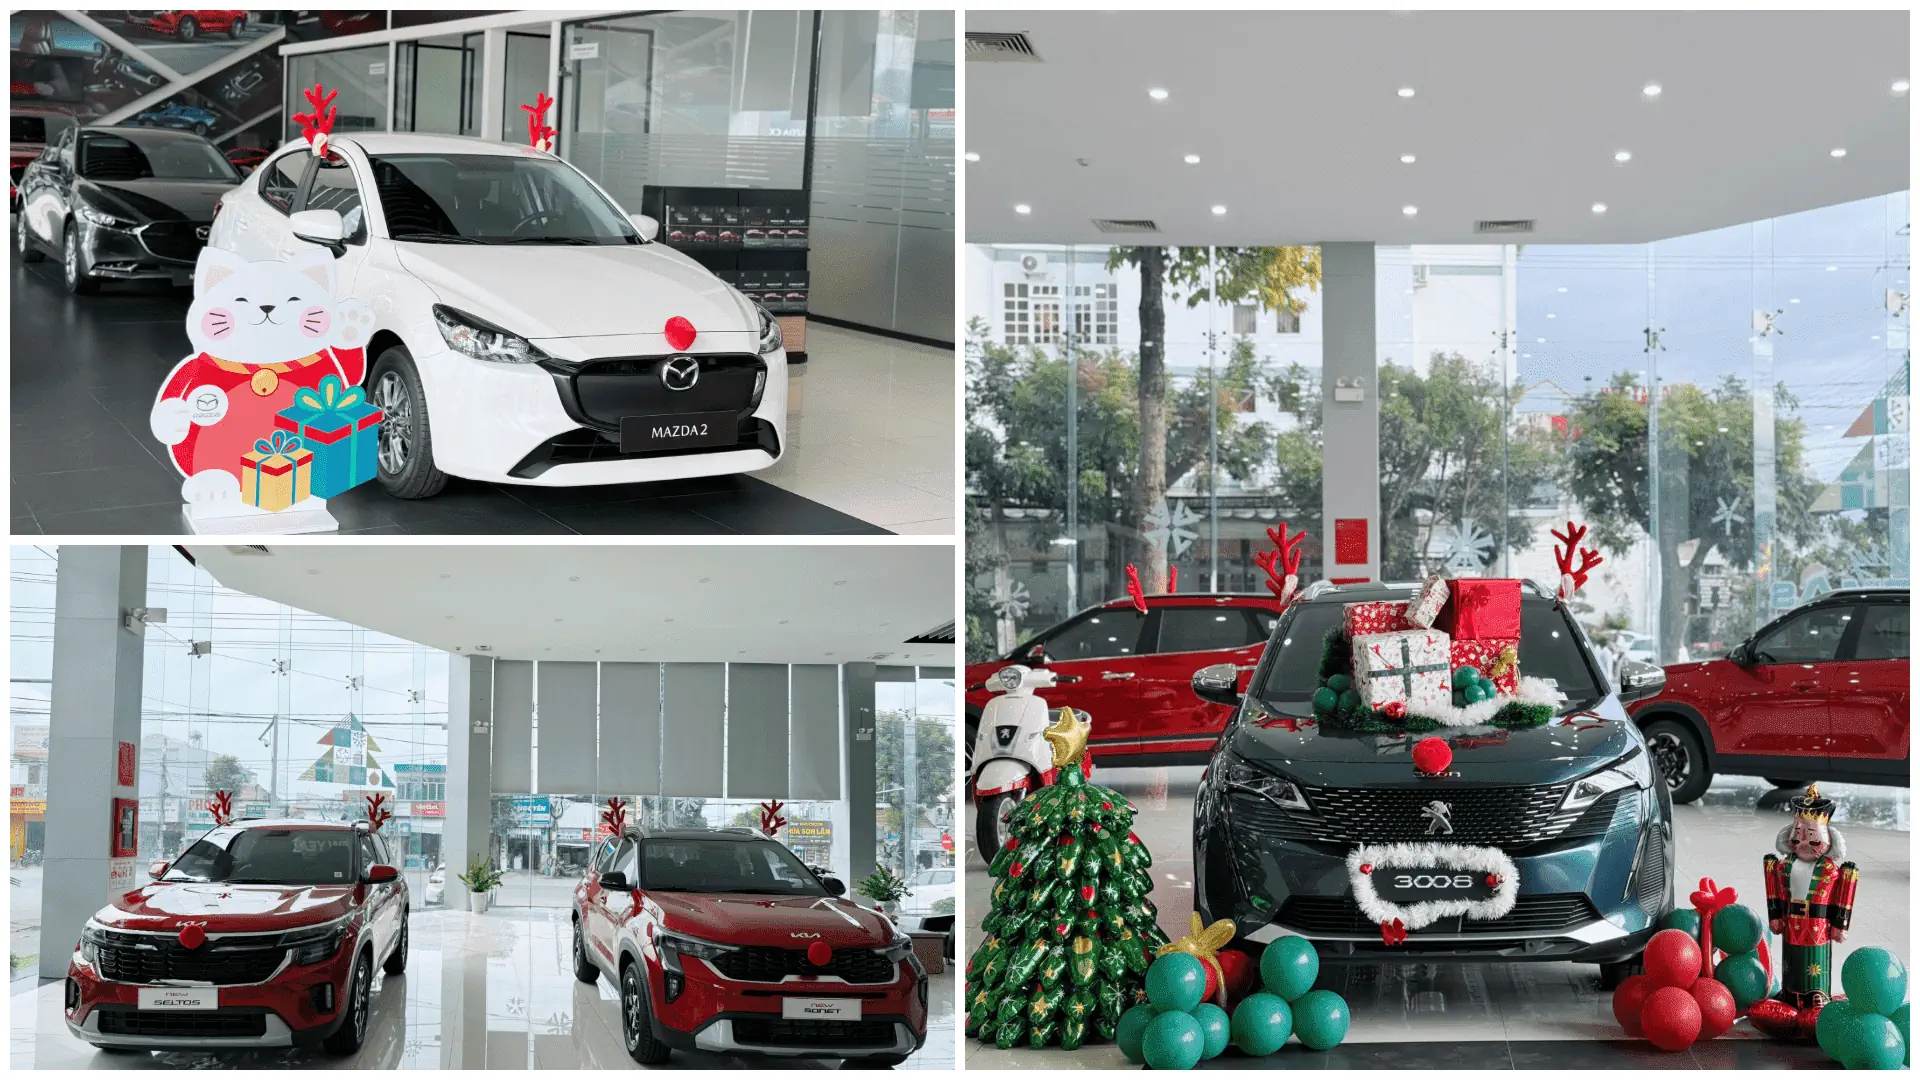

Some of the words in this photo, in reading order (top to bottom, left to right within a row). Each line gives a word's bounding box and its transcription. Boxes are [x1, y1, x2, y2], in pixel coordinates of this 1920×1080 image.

[651, 424, 699, 439] MAZDA
[699, 423, 708, 436] 2
[1393, 875, 1475, 889] 3008
